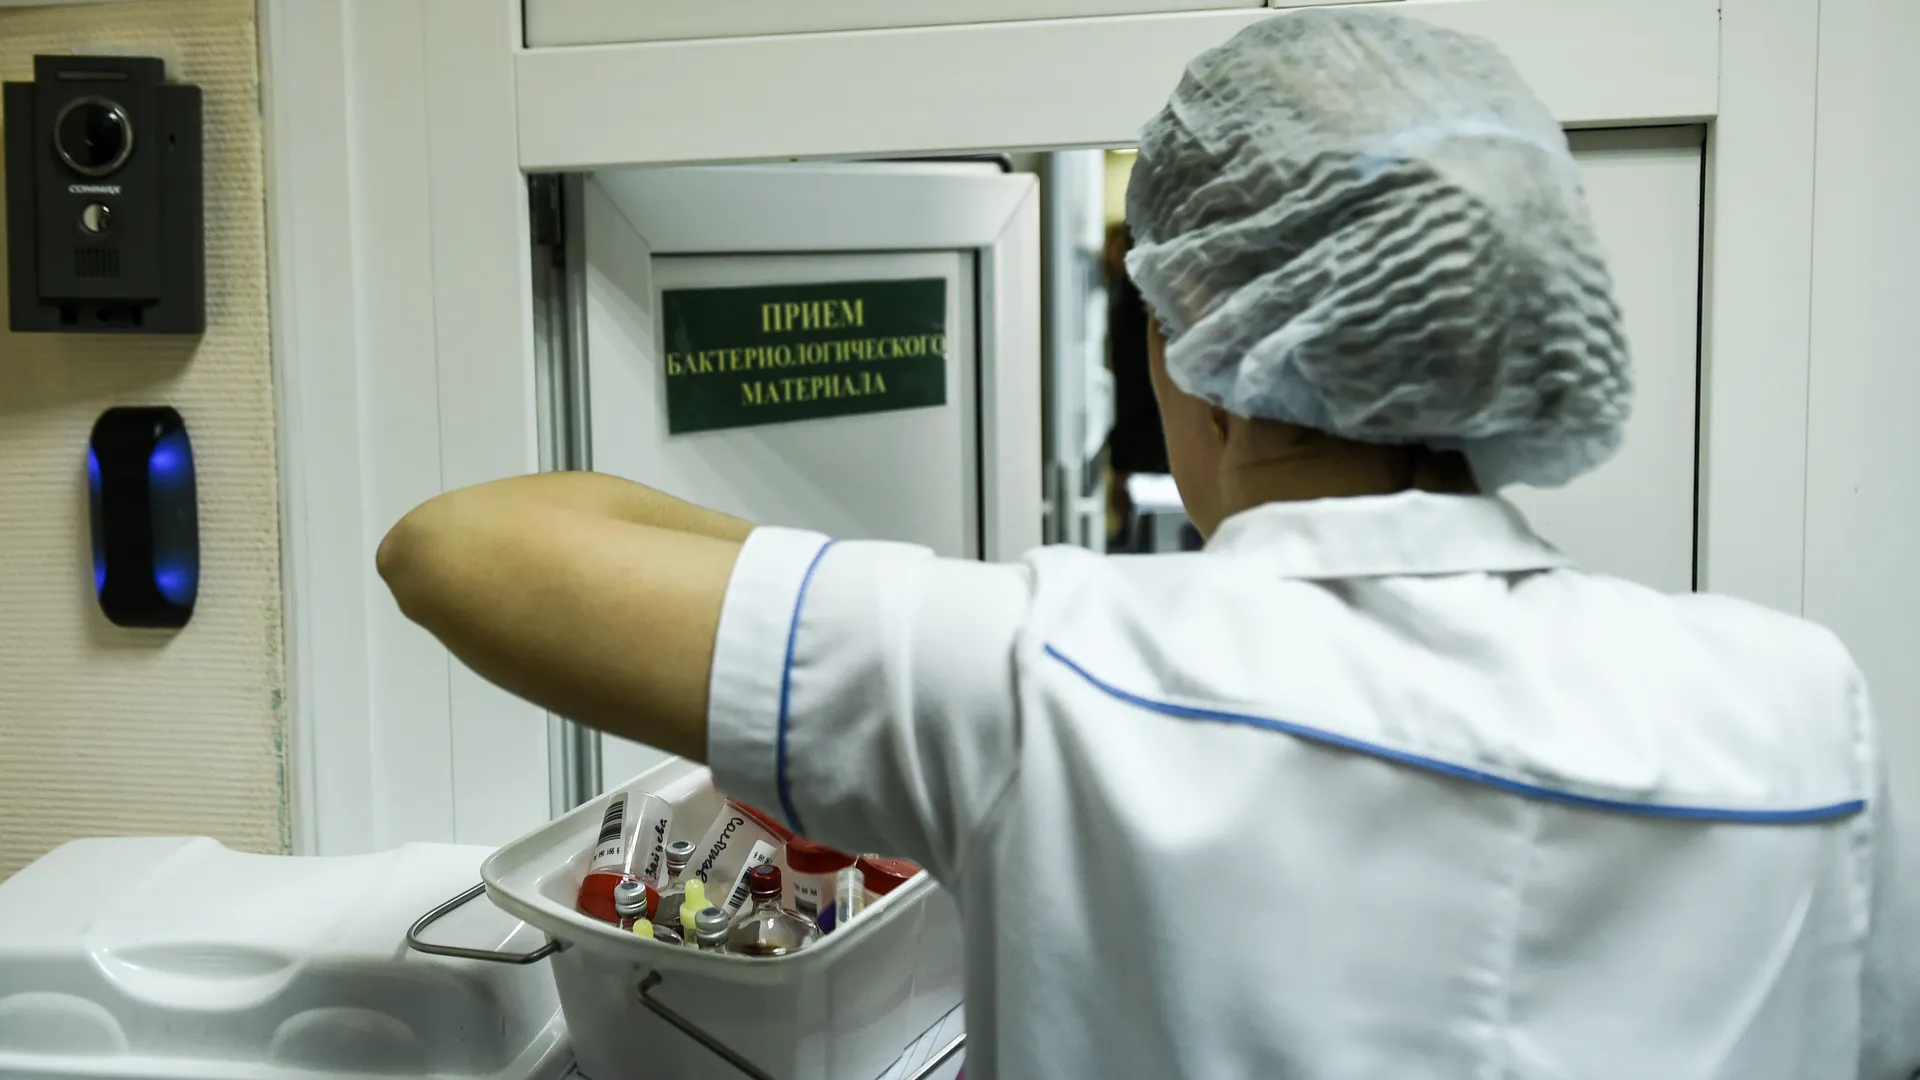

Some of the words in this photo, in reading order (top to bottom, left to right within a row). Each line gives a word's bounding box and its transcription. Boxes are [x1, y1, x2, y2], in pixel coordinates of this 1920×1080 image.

[761, 299, 865, 332] ПРИЕМ
[667, 334, 946, 375] БАКТЕРИОЛОГИЧЕСКОГО
[741, 372, 886, 405] МАТЕРИАЛА
